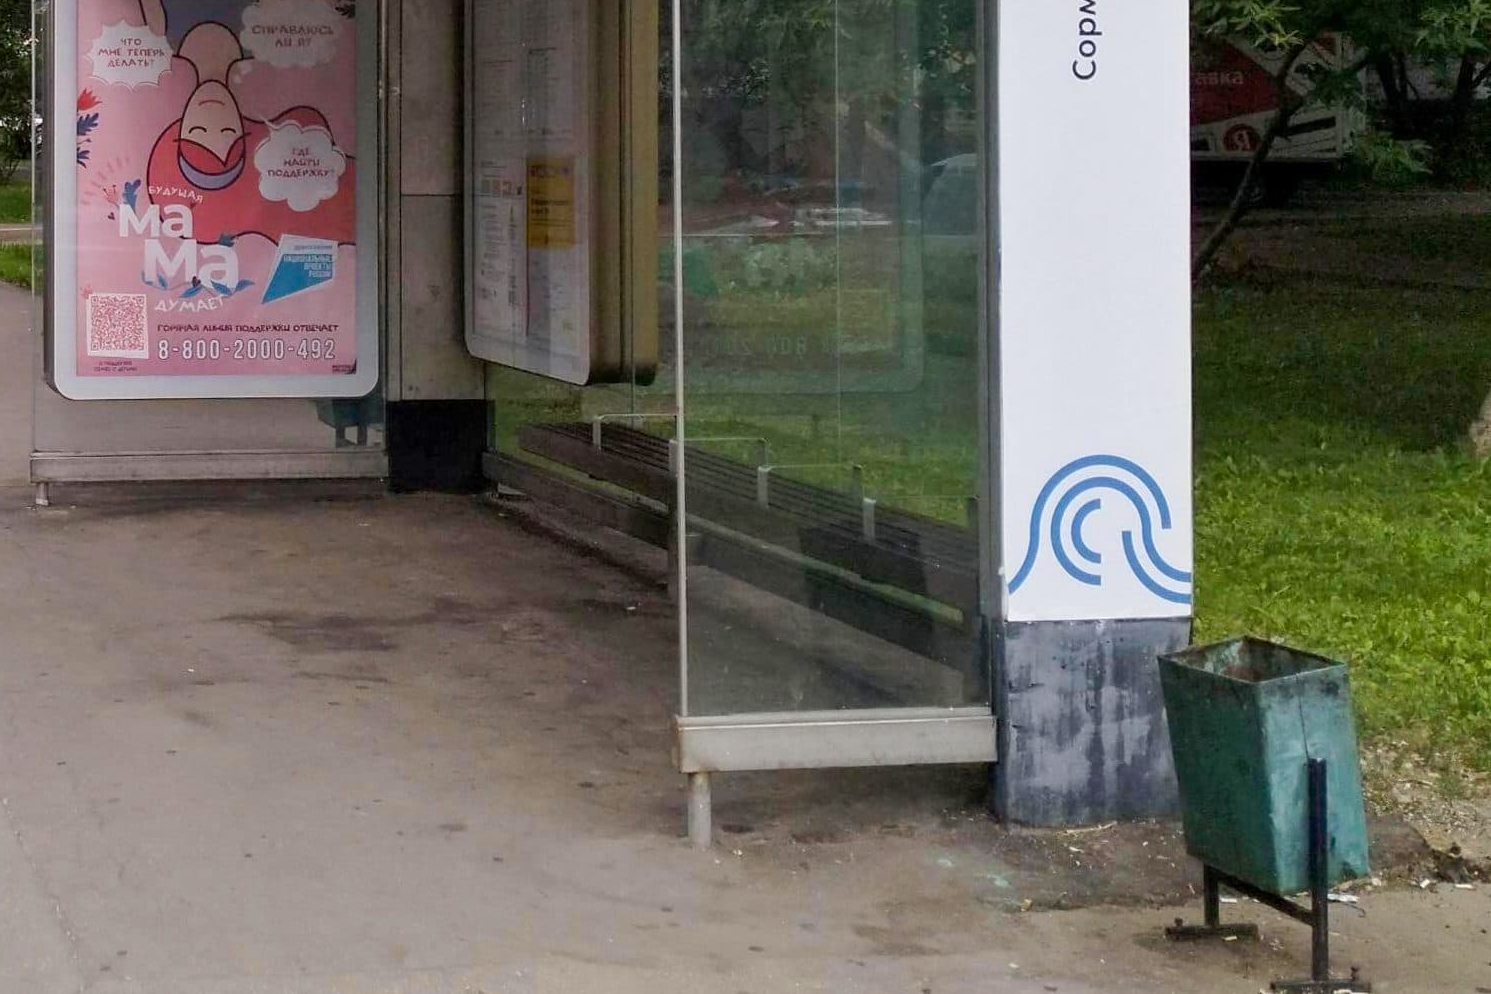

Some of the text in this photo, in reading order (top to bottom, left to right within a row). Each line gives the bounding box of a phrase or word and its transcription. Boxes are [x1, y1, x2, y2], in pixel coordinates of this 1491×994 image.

[120, 38, 142, 46] ЧТО
[98, 48, 165, 57] МНЕ ТЕПЕРЬ
[154, 295, 225, 313] ДУМАЕТ
[158, 338, 336, 360] 8-800-2000-492
